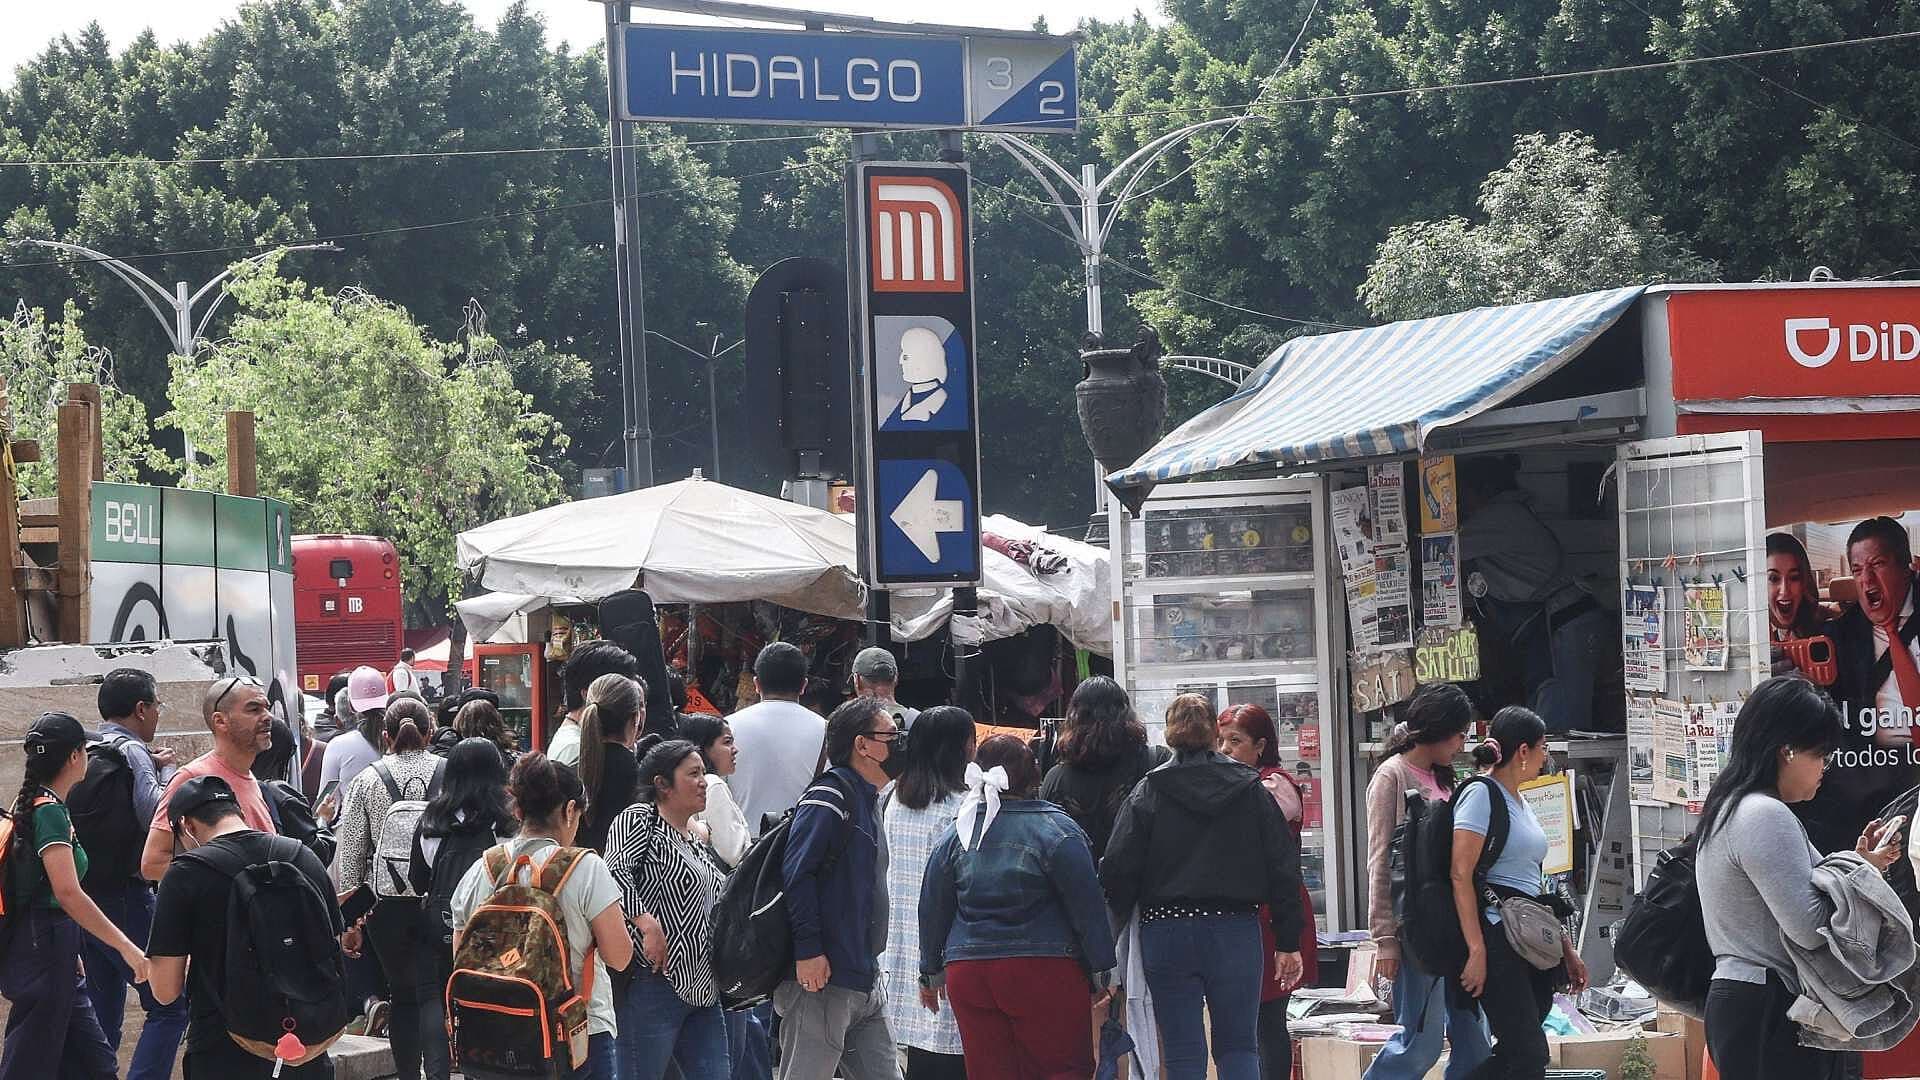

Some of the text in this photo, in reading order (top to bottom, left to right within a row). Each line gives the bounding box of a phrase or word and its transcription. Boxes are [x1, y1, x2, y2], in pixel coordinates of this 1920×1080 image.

[670, 50, 922, 102] HIDALGO
[986, 56, 1012, 90] 3
[1039, 80, 1065, 115] 2
[106, 501, 160, 545] BELL
[1416, 646, 1448, 684] SAT
[1356, 668, 1400, 710] SAT
[1684, 725, 1697, 737] La
[1835, 744, 1899, 768] todos
